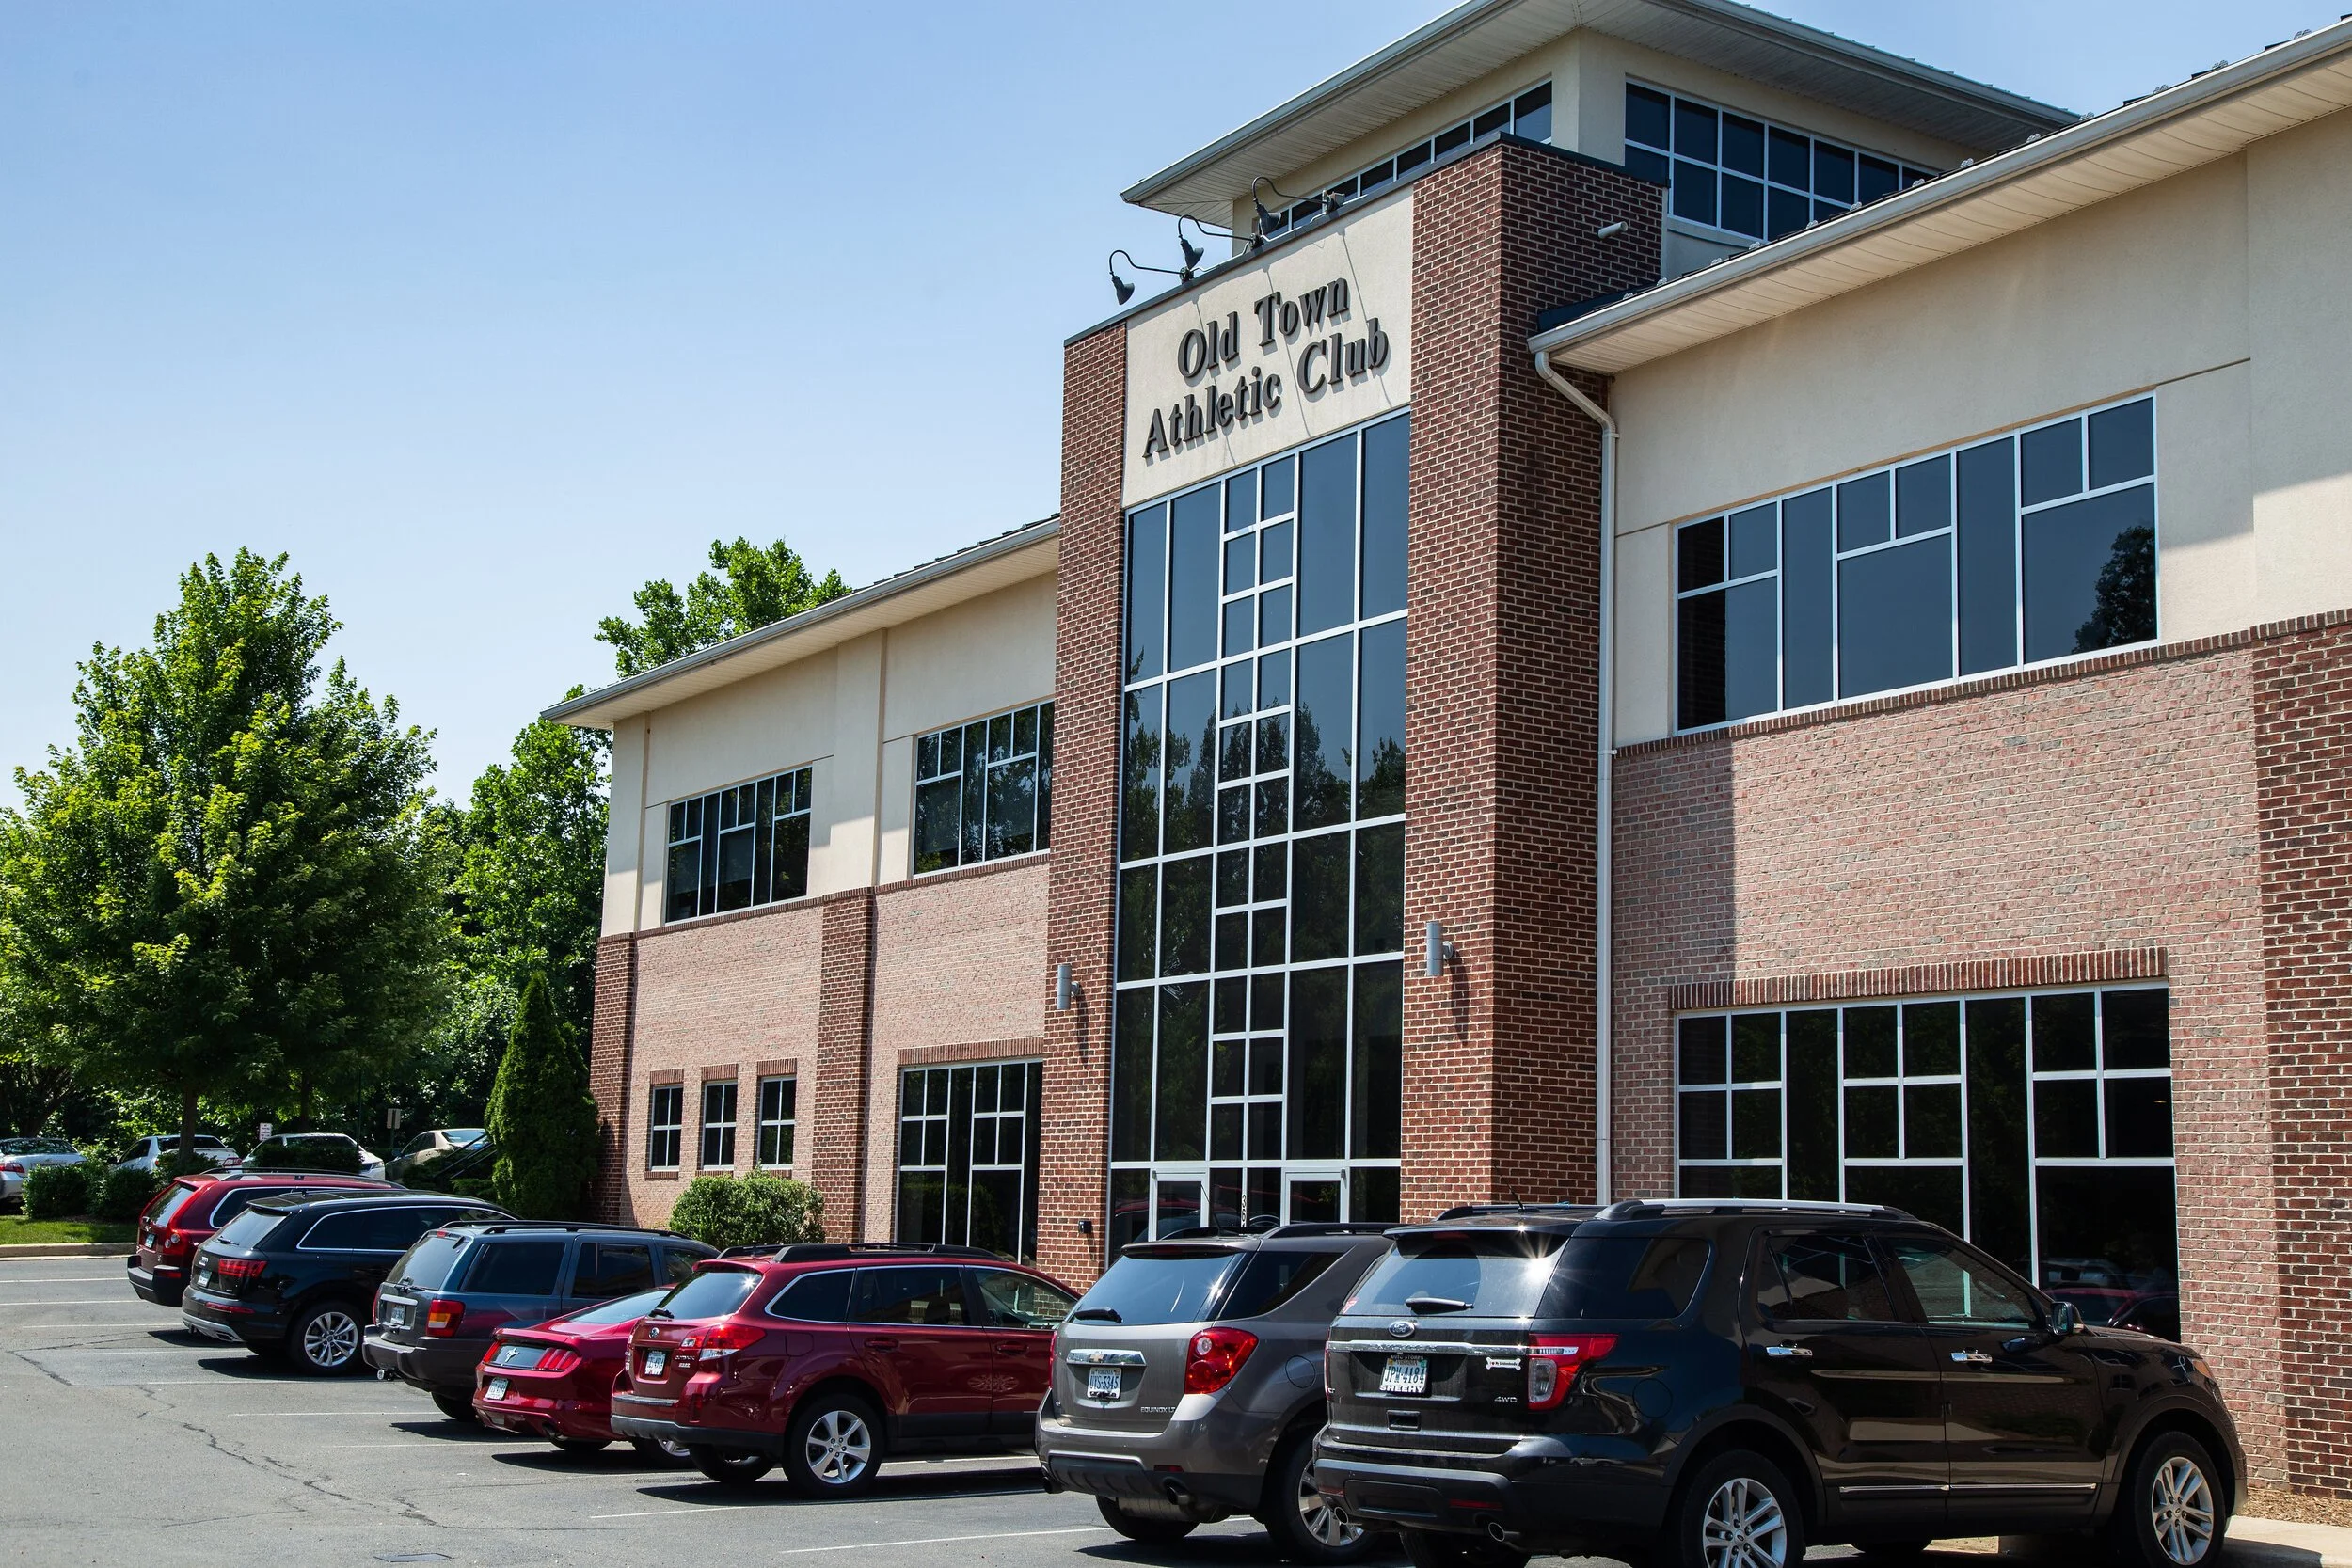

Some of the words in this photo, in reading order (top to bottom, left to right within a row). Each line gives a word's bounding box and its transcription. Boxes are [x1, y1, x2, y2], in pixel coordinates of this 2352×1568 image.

[1178, 311, 1239, 378] Old
[1255, 277, 1350, 347] Town
[1142, 366, 1281, 459] Athletic
[1297, 317, 1389, 394] Club
[1379, 1384, 1424, 1393] SHEEHY
